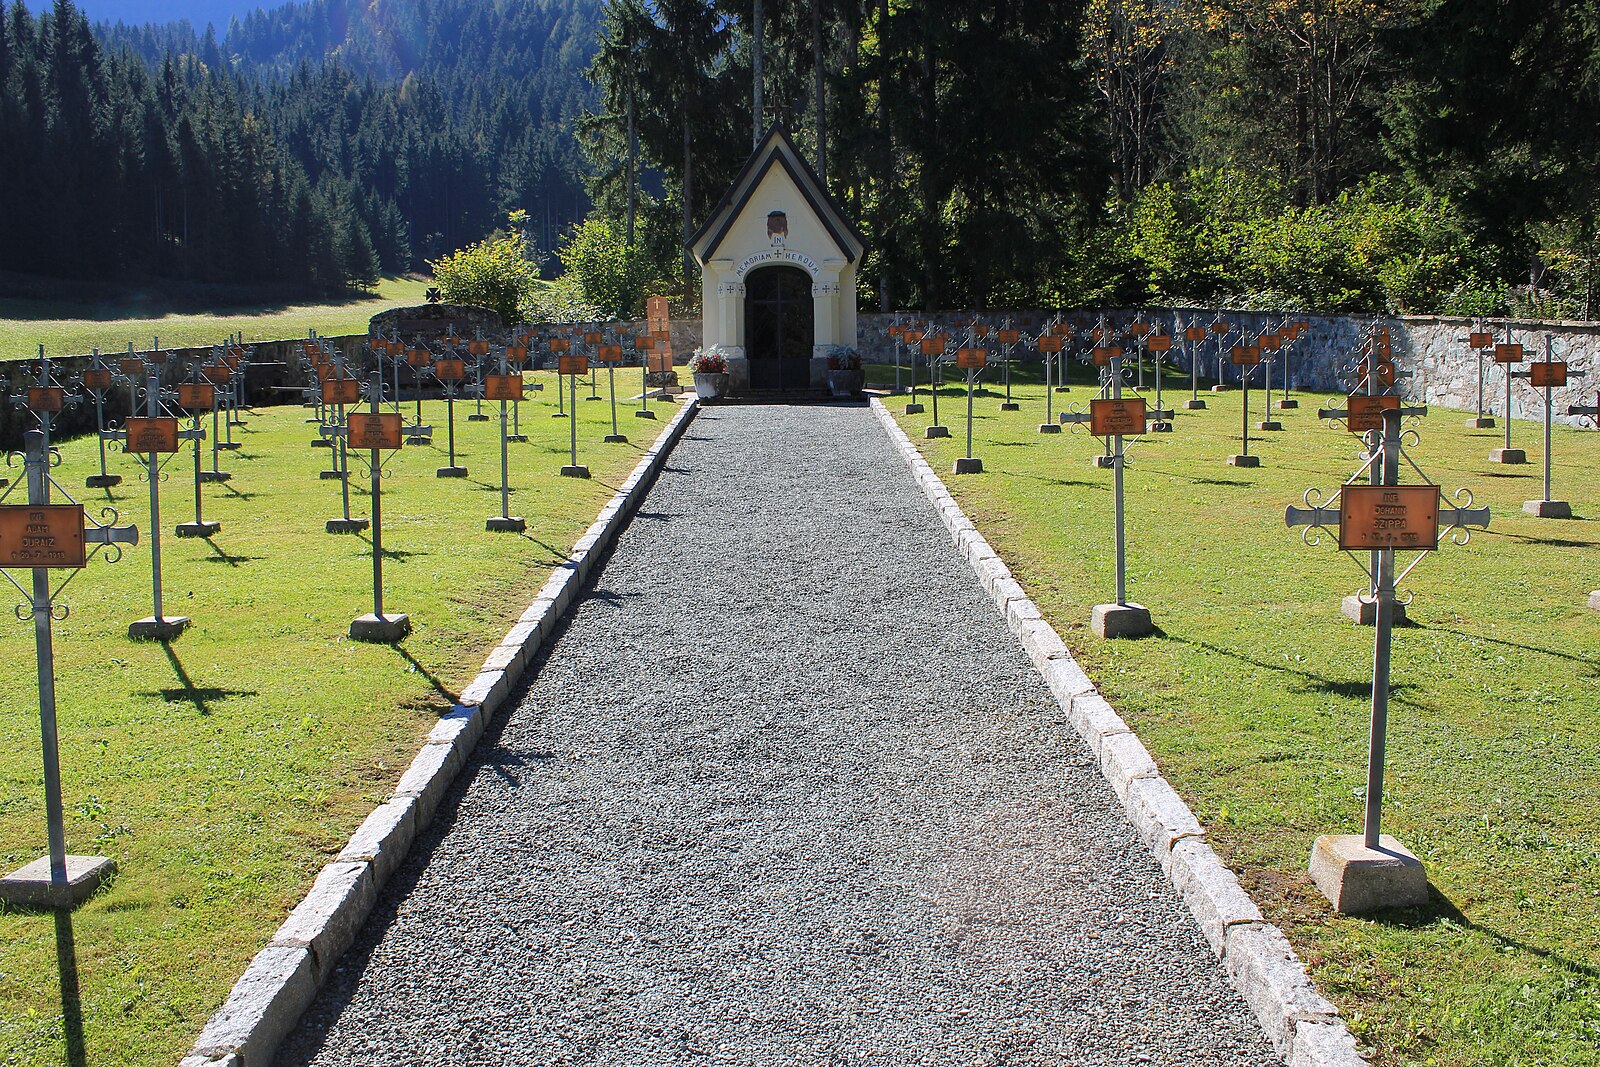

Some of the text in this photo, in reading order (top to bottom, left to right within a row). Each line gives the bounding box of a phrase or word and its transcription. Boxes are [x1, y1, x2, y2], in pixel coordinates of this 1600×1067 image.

[736, 252, 772, 277] MEMORIAM
[27, 524, 49, 534] ADAM
[1373, 518, 1407, 529] SZIPPA
